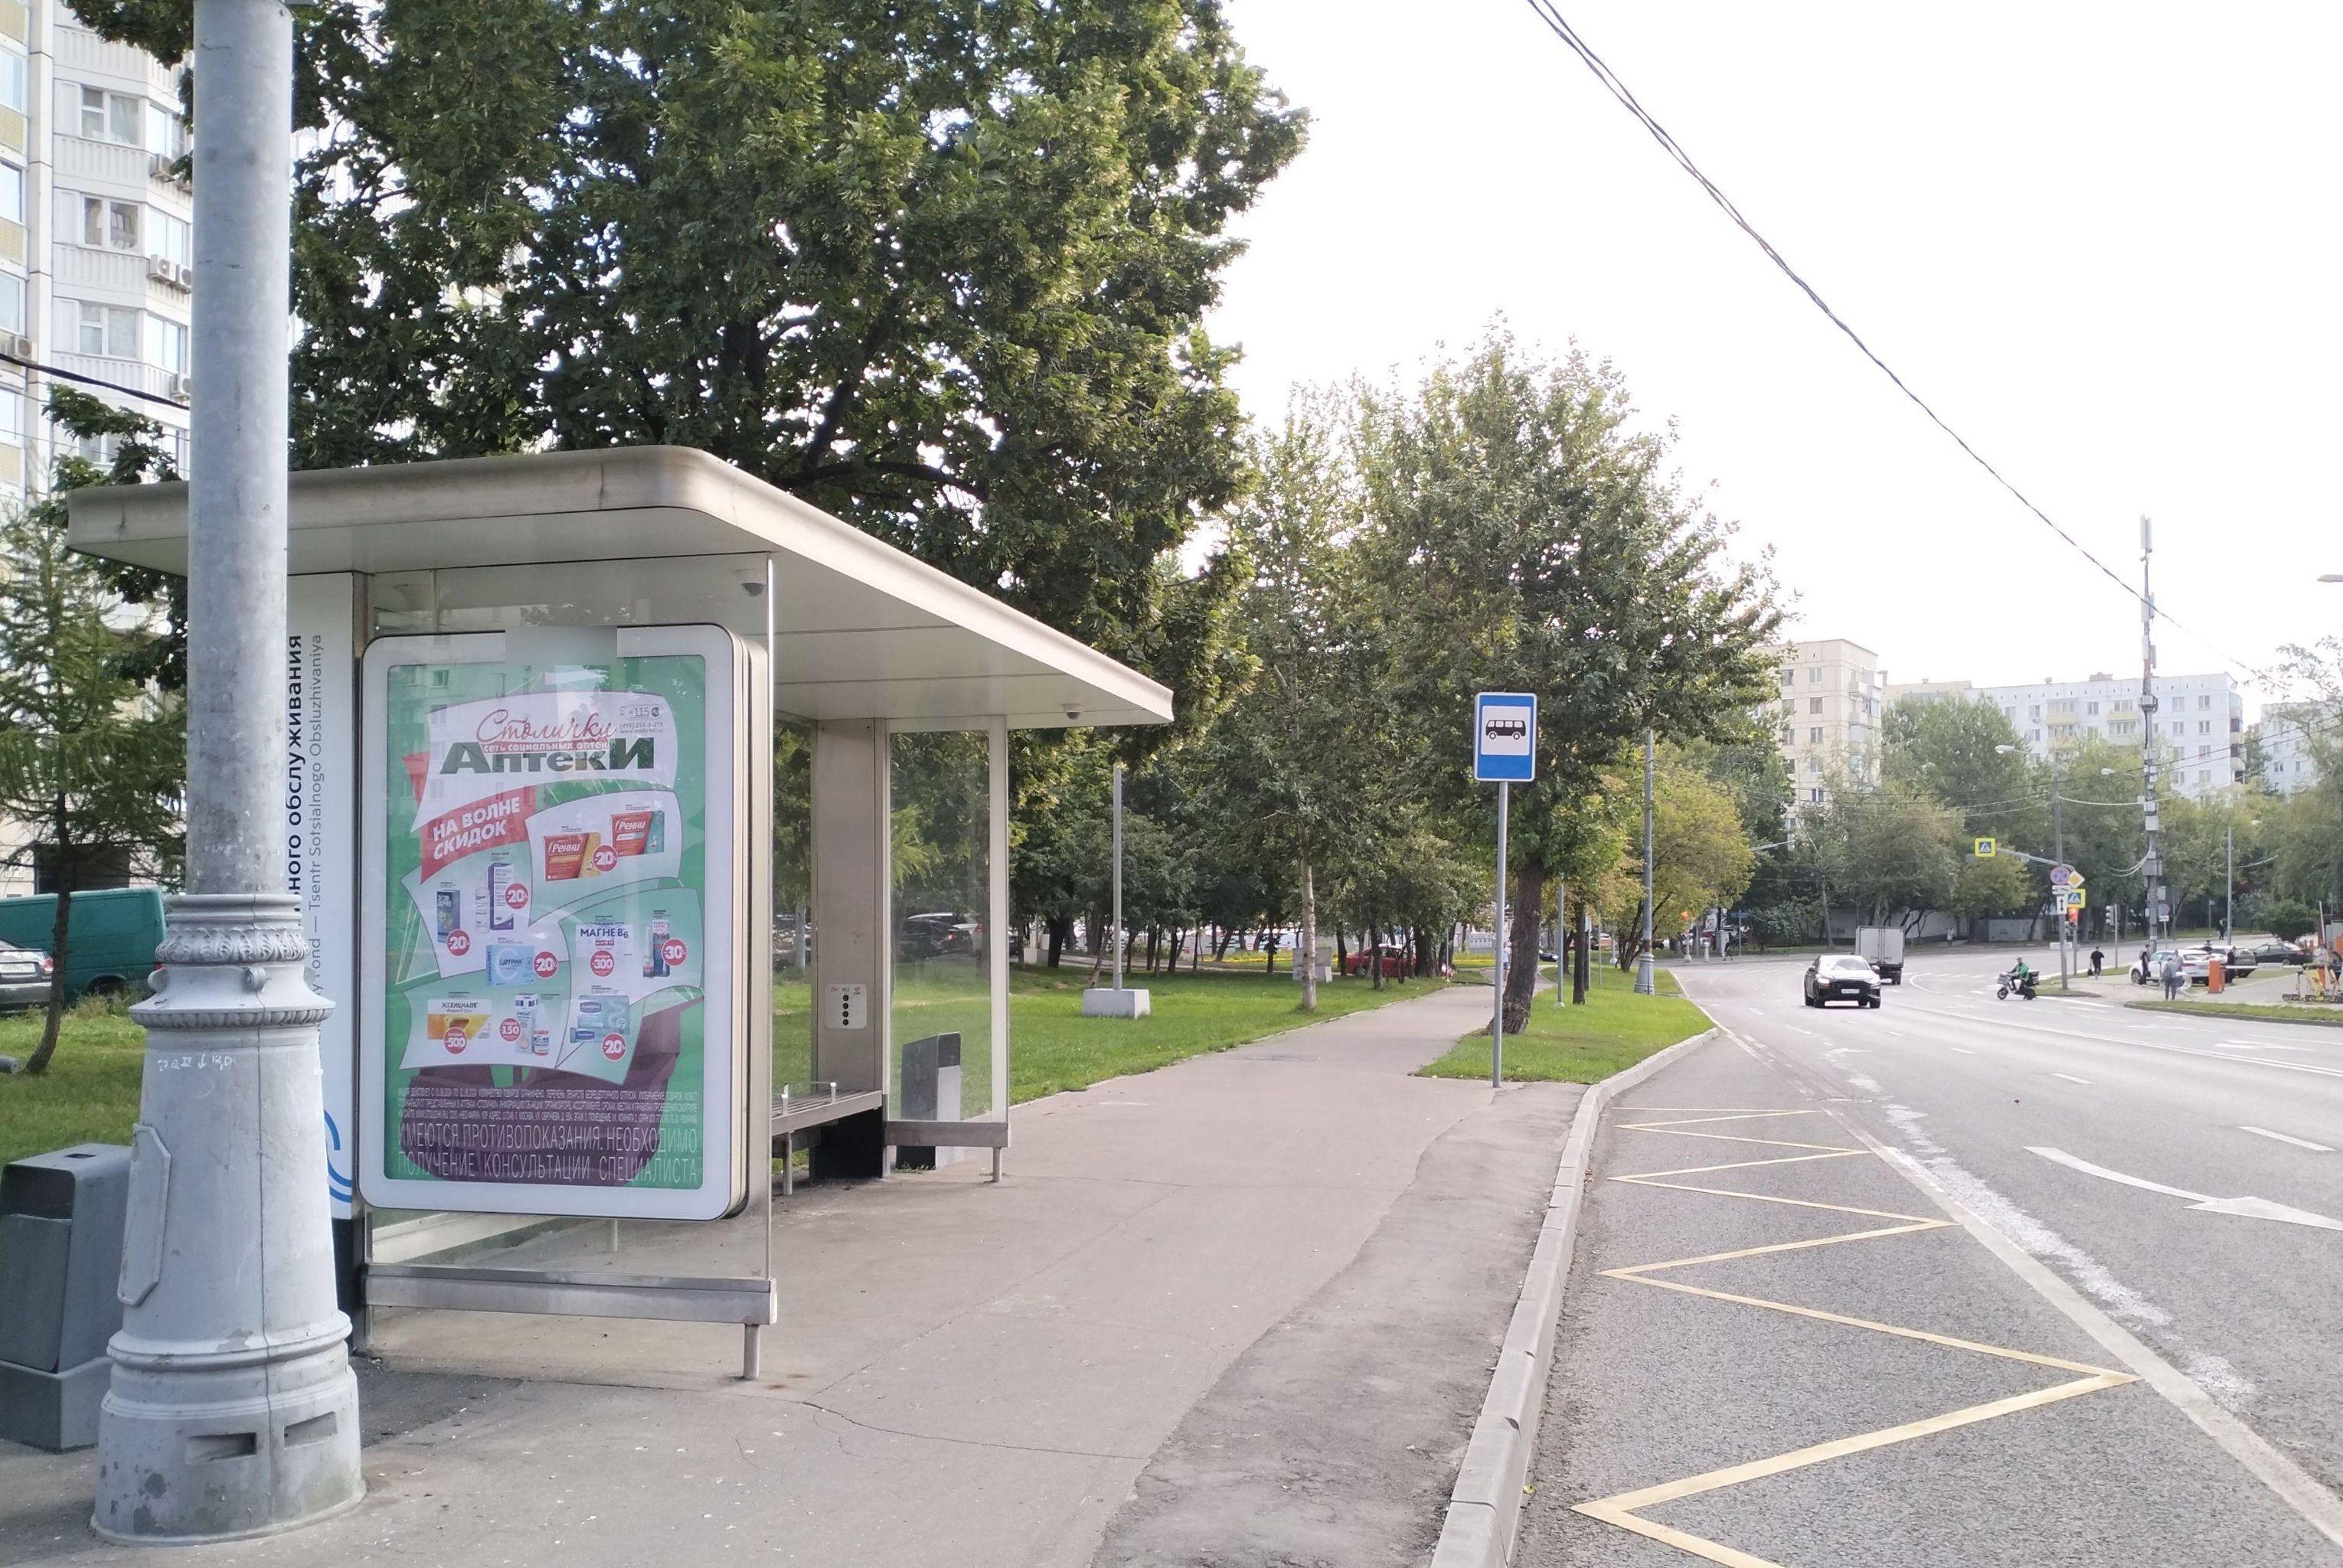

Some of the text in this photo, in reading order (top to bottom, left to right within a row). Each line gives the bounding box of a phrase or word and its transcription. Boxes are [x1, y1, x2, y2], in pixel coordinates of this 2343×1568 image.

[309, 635, 325, 757] Obsluzhivaniya
[286, 635, 306, 826] обслуживания
[476, 709, 617, 742] Столички
[484, 740, 609, 753] сеть социальных аптек
[309, 763, 325, 857] Sotsialnogo
[433, 797, 520, 841] НА ВОЛНЕ
[433, 820, 507, 861] СКИДОК
[309, 862, 321, 911] Tsentr
[580, 928, 616, 937] МАГНЕ
[399, 1124, 698, 1155] ИМЕЮТСЯ ПРОТИВОПОКАЗАНИЯ. НЕОБХОДИМО
[399, 1152, 698, 1184] ПОЛУЧЕНИЕ КОНСУЛЬТАЦИИ СПЕЦИАЛИСТА
